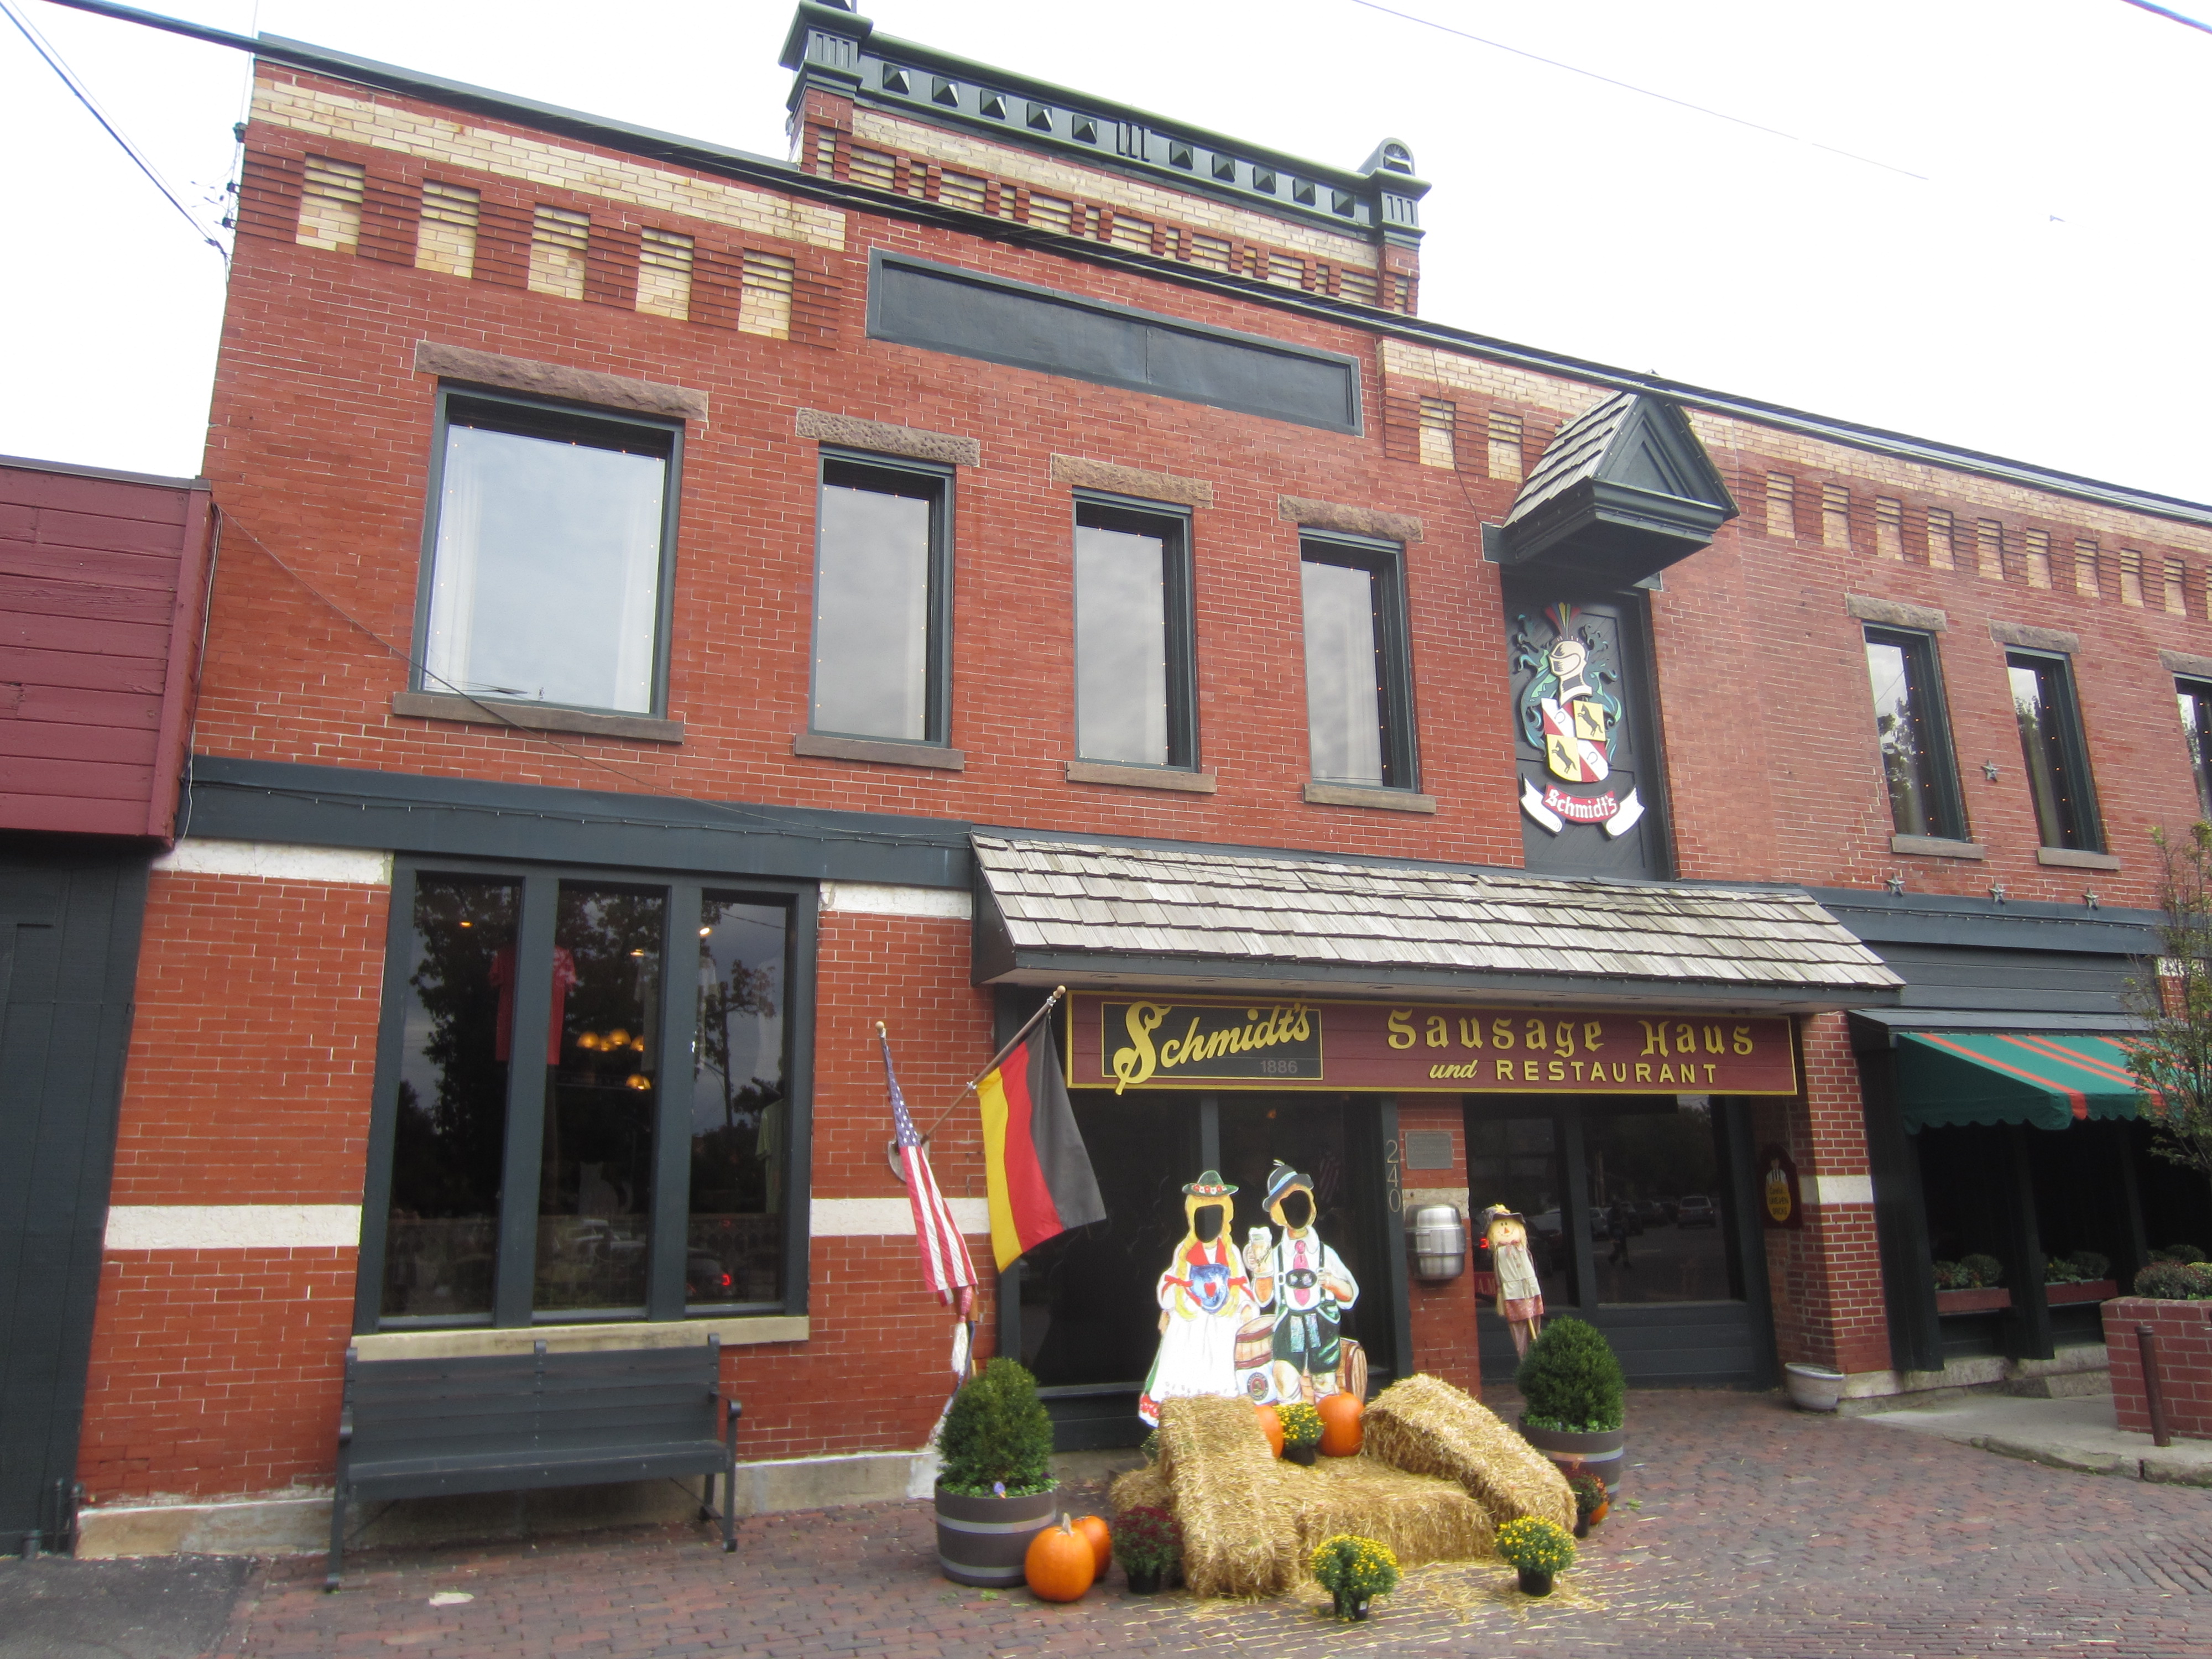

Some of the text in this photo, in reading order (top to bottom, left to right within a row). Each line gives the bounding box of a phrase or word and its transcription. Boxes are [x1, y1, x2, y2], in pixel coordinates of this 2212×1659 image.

[1545, 789, 1617, 818] Schmidt's
[1113, 1000, 1311, 1095] Schmidt's
[1387, 1009, 1754, 1058] Sausage Haus
[1260, 1060, 1298, 1074] 1886
[1430, 1060, 1717, 1083] und RESTAURANT
[1386, 1140, 1401, 1212] 240
